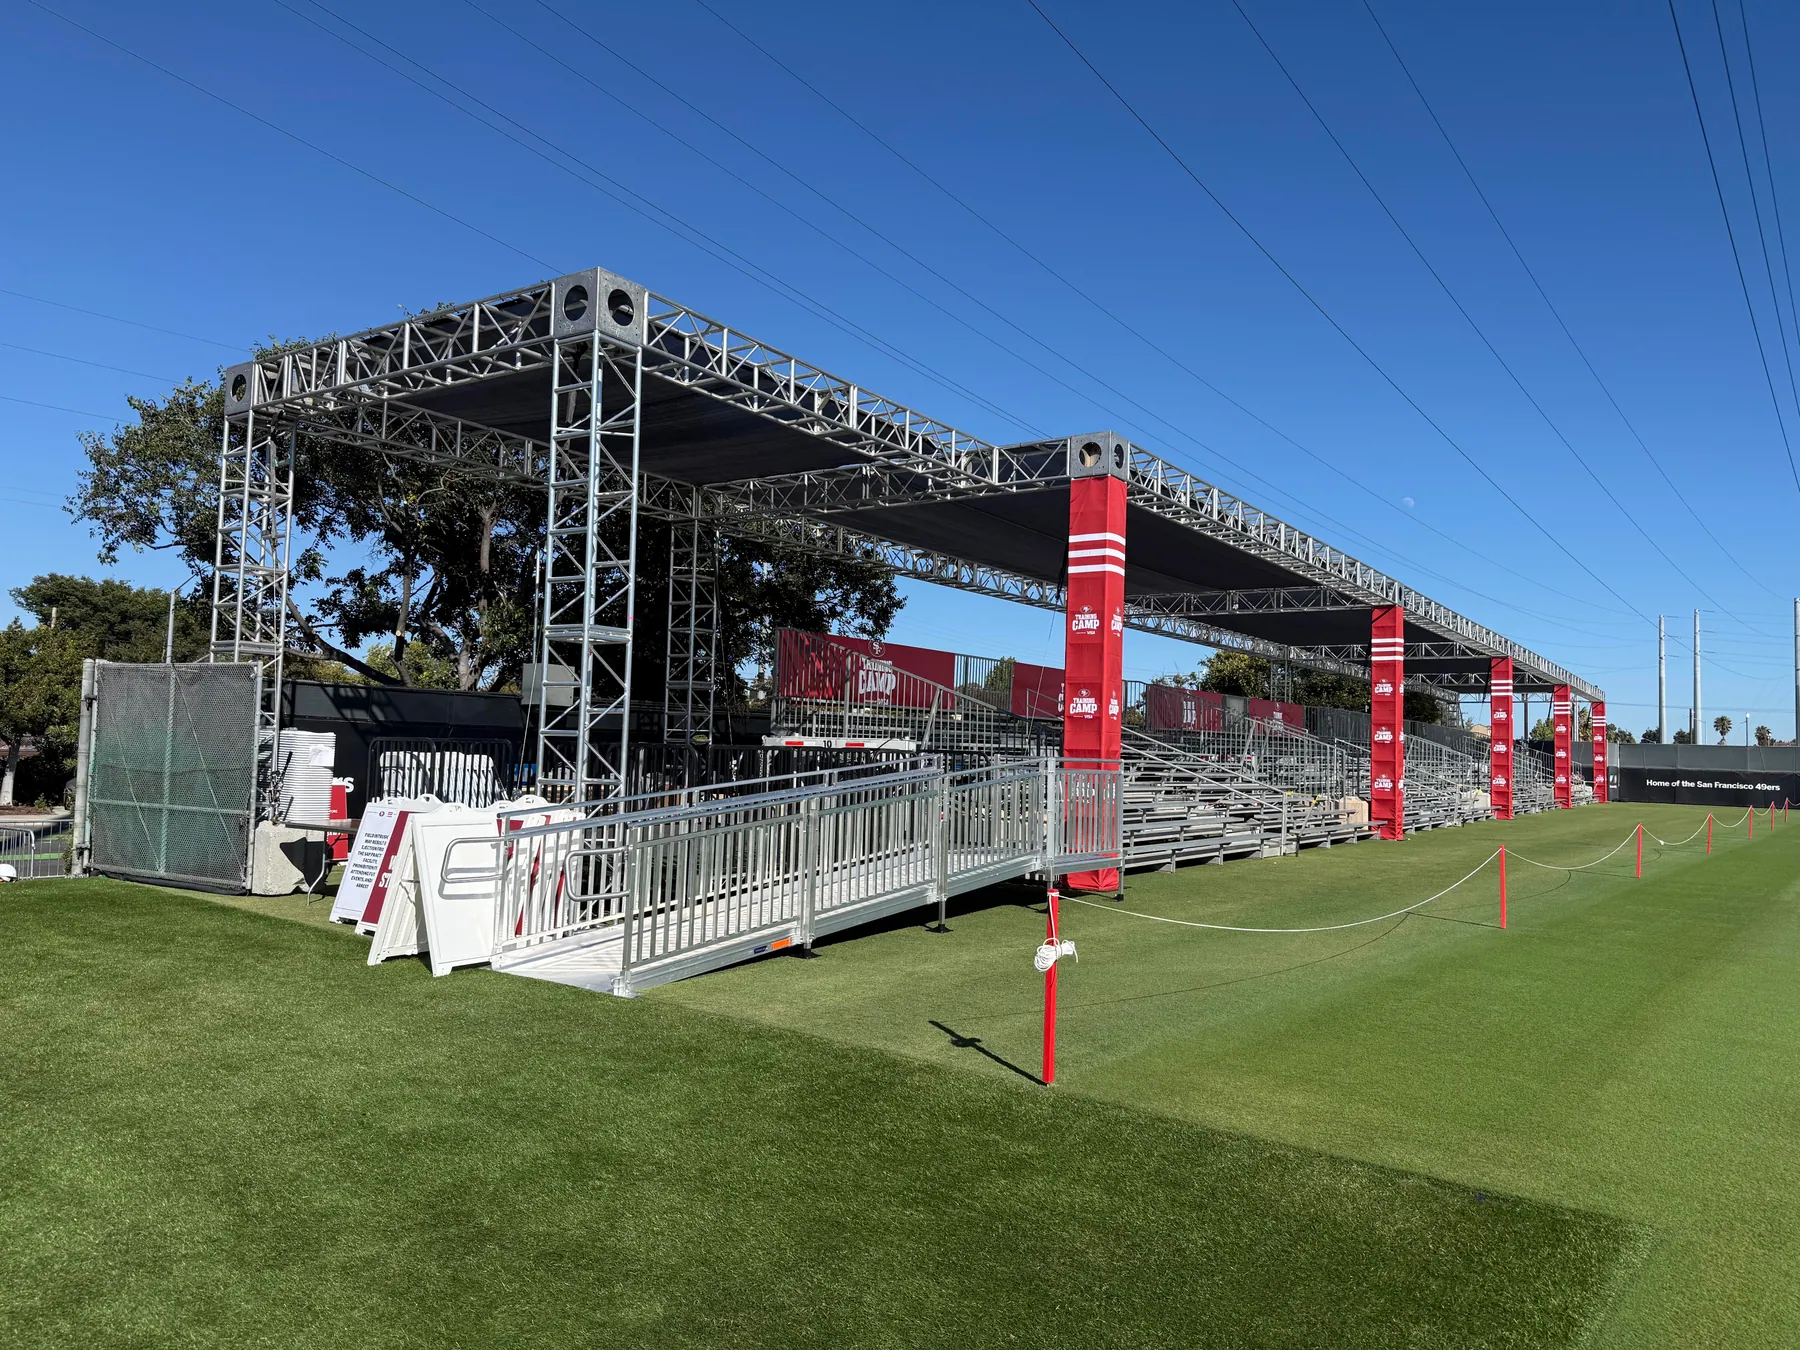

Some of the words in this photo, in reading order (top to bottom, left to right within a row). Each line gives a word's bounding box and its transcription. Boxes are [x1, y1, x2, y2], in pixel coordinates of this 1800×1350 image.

[1072, 619, 1099, 631] CAMP
[859, 670, 896, 695] CAMP
[1070, 703, 1097, 714] CAMP
[823, 740, 832, 748] 10
[1646, 779, 1670, 787] Home
[1681, 780, 1695, 788] the
[1696, 780, 1713, 788] San
[1714, 781, 1754, 790] Francisco
[1755, 782, 1780, 791] 49ers
